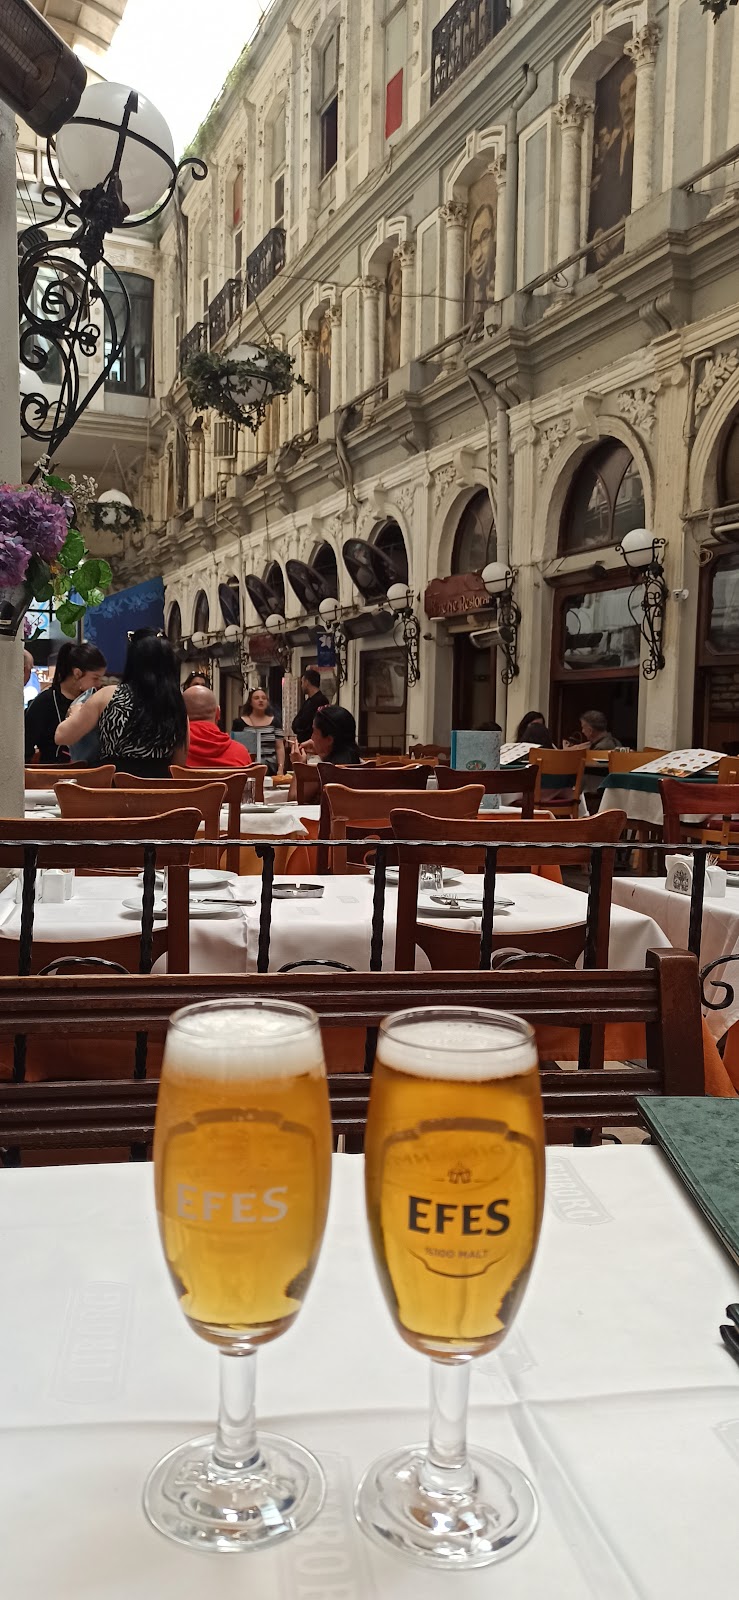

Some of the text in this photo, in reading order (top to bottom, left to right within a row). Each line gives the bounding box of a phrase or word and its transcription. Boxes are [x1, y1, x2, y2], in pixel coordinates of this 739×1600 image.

[176, 1183, 289, 1224] EFES
[408, 1195, 511, 1237] EFES
[458, 1248, 489, 1259] MALT
